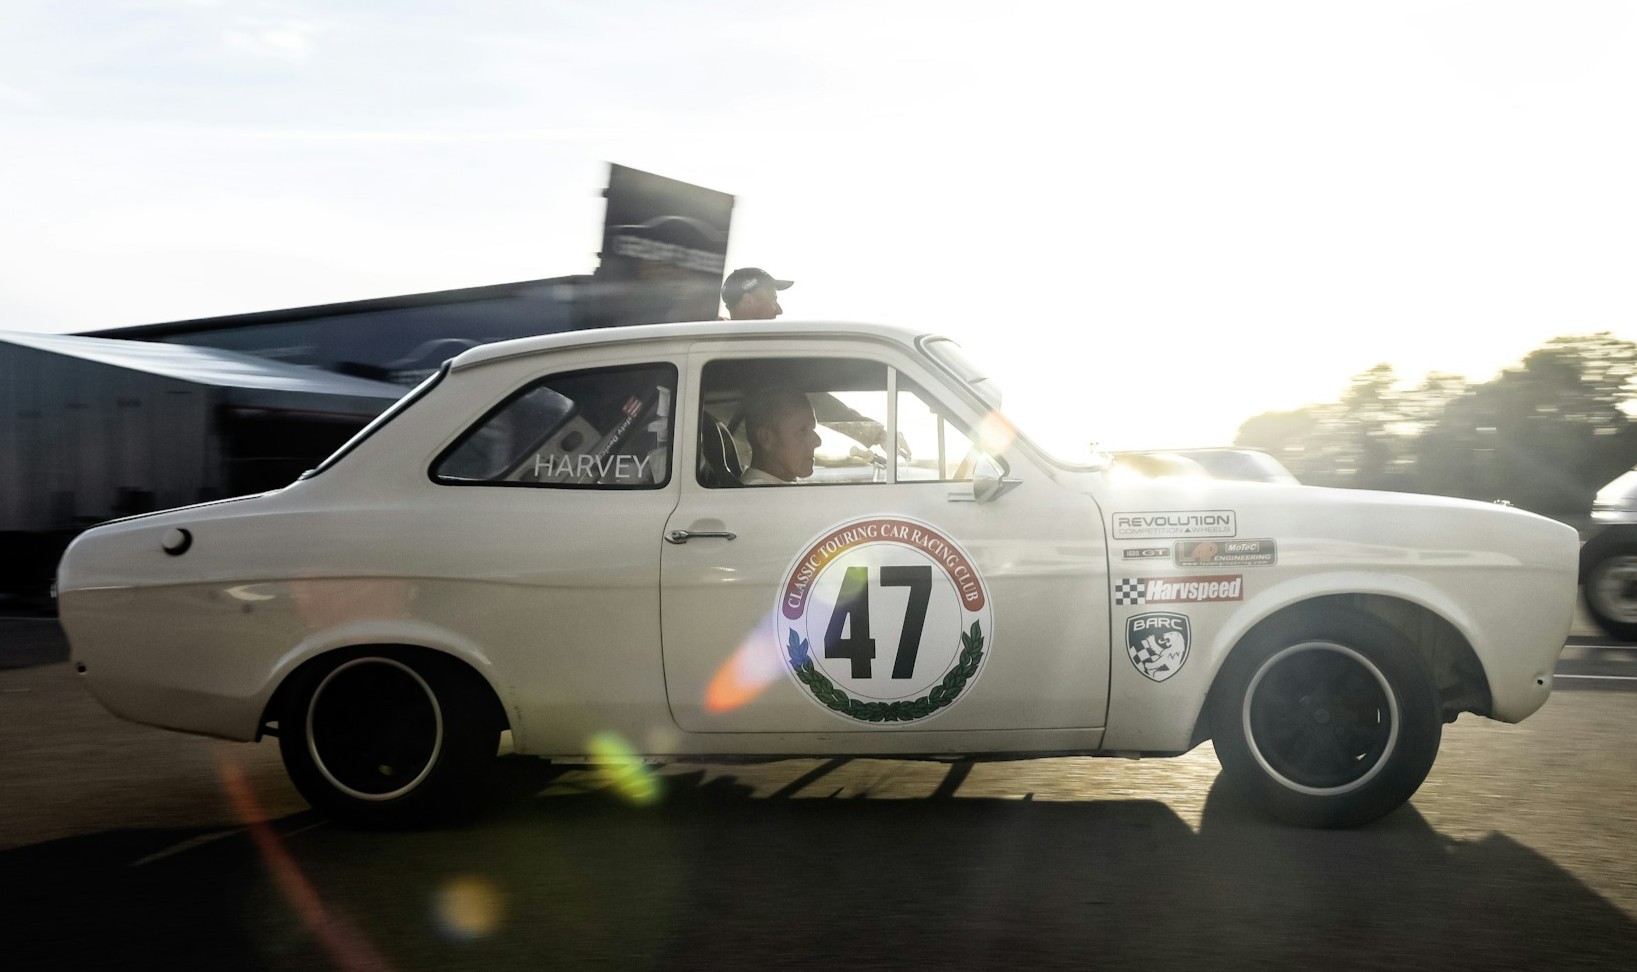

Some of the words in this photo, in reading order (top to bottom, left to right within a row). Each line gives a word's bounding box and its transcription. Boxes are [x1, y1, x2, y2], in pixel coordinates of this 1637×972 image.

[534, 453, 651, 478] HARVEY
[1118, 515, 1230, 527] REVOLUTION
[1118, 527, 1183, 535] COMPETITION
[1192, 526, 1231, 534] WHEELS
[1227, 543, 1257, 552] MoTeC
[1213, 553, 1271, 562] ENGINEERING
[787, 554, 822, 609] CLASSIC
[817, 524, 878, 559] TOURING
[880, 523, 908, 539] CAR
[911, 527, 960, 568] RACING
[954, 564, 979, 602] CLUB
[1145, 578, 1242, 601] Harvspeed
[823, 565, 933, 680] 47
[1133, 617, 1184, 631] BARC
